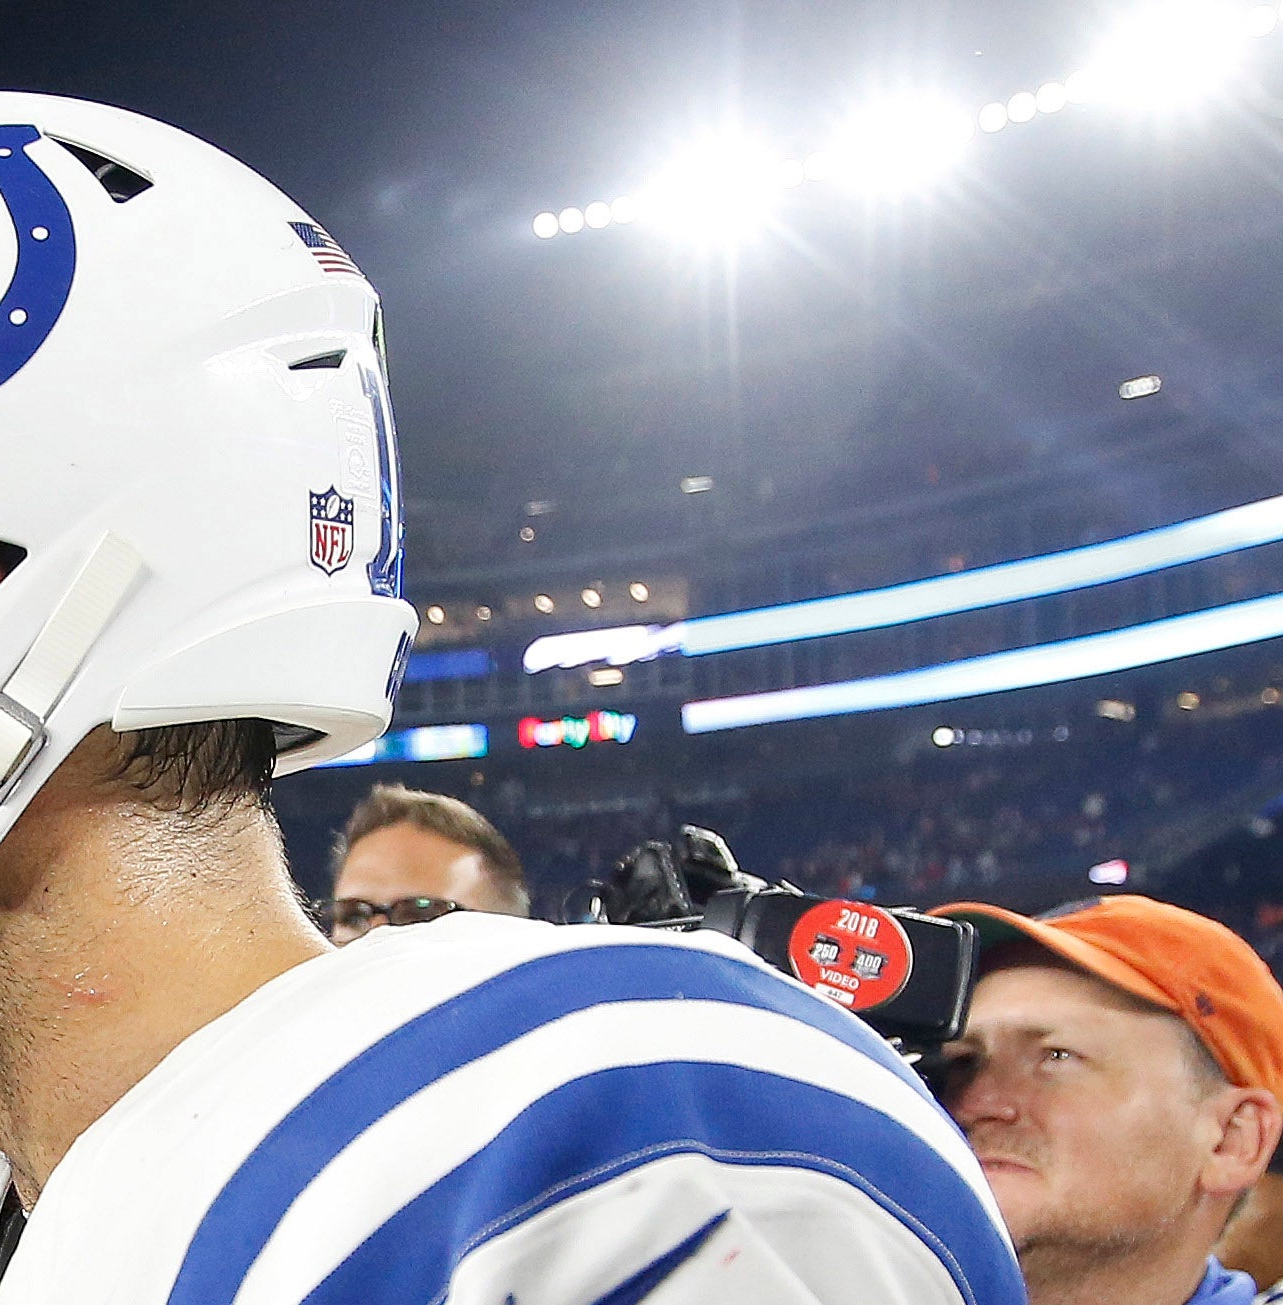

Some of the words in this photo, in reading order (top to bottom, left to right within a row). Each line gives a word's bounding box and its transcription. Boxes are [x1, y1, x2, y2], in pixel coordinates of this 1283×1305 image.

[314, 522, 350, 566] NFL
[836, 908, 880, 938] 2018
[813, 942, 839, 961] 250
[856, 953, 883, 972] 400
[820, 967, 860, 990] VIDEO
